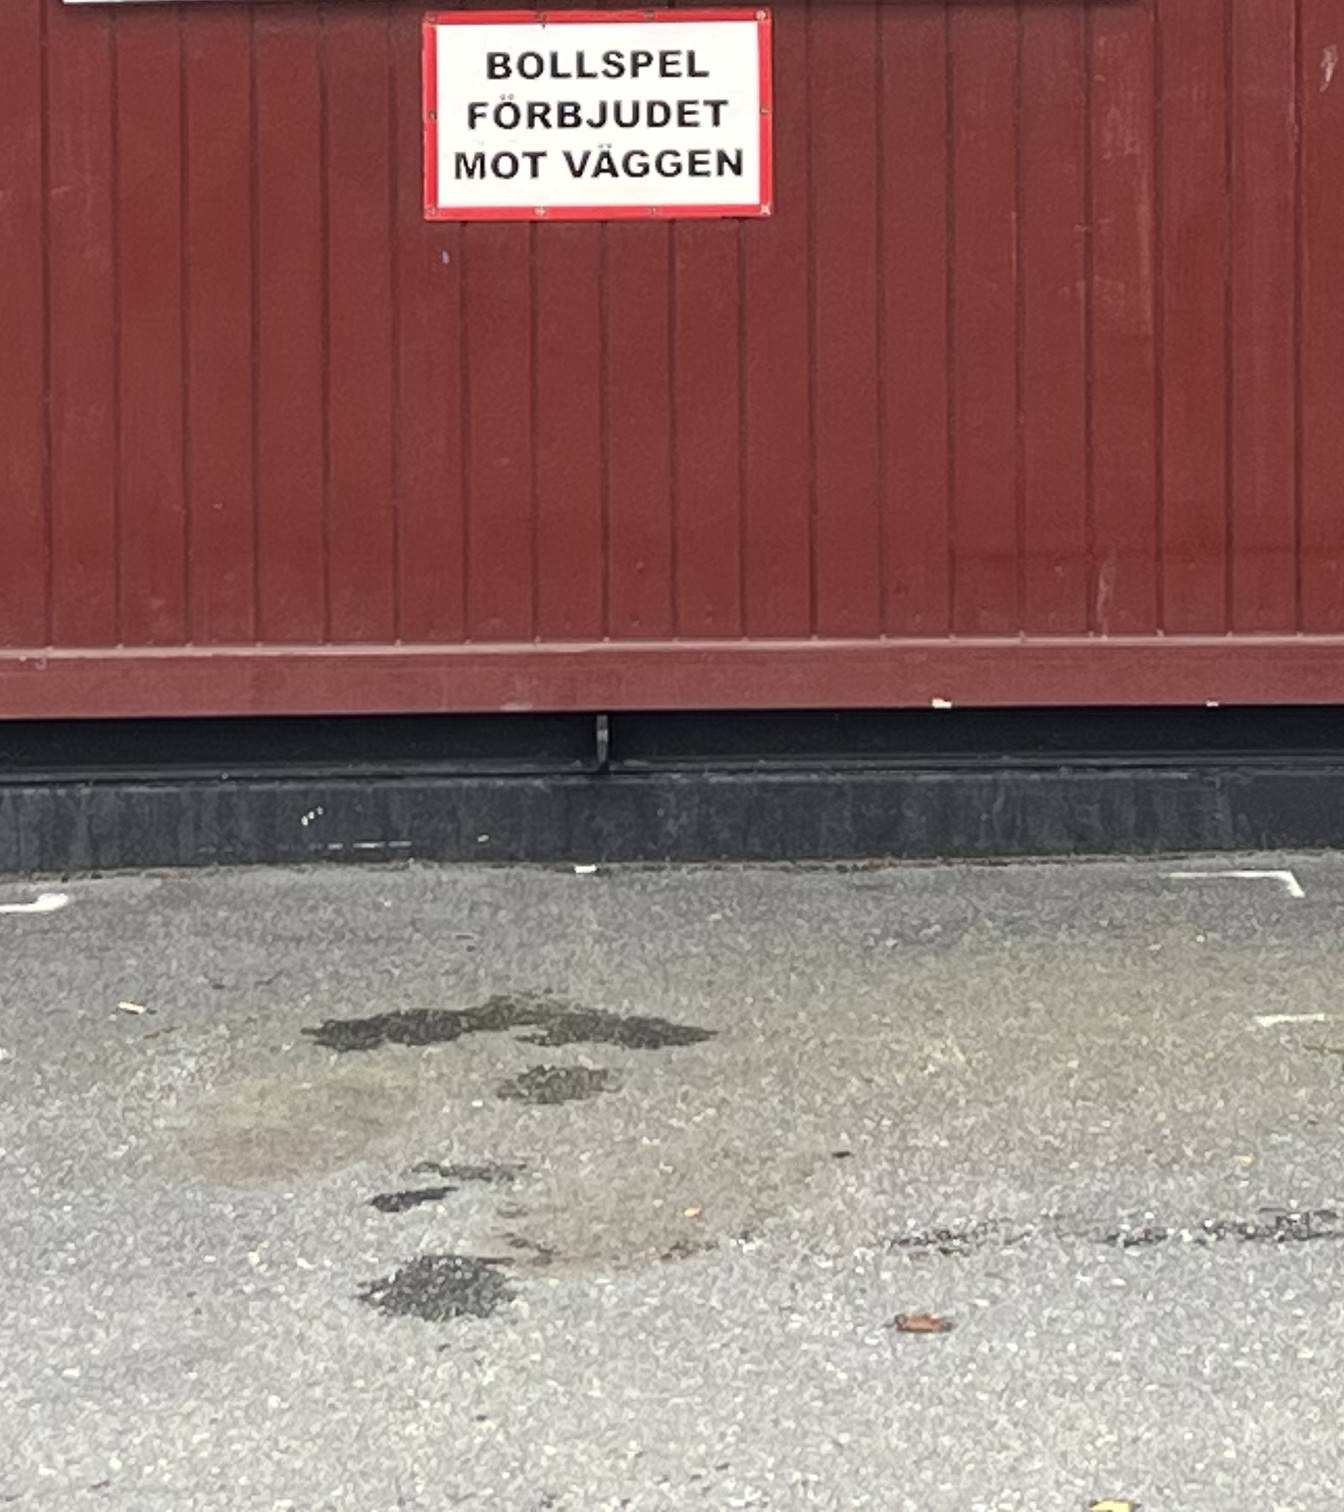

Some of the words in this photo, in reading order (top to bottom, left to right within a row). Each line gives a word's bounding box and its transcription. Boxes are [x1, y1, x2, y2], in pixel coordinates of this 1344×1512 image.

[487, 50, 709, 80] BOLLSPEL
[468, 94, 728, 130] FÖRBJUDET
[455, 151, 547, 179] MOT
[563, 143, 742, 178] VÄGGEN
